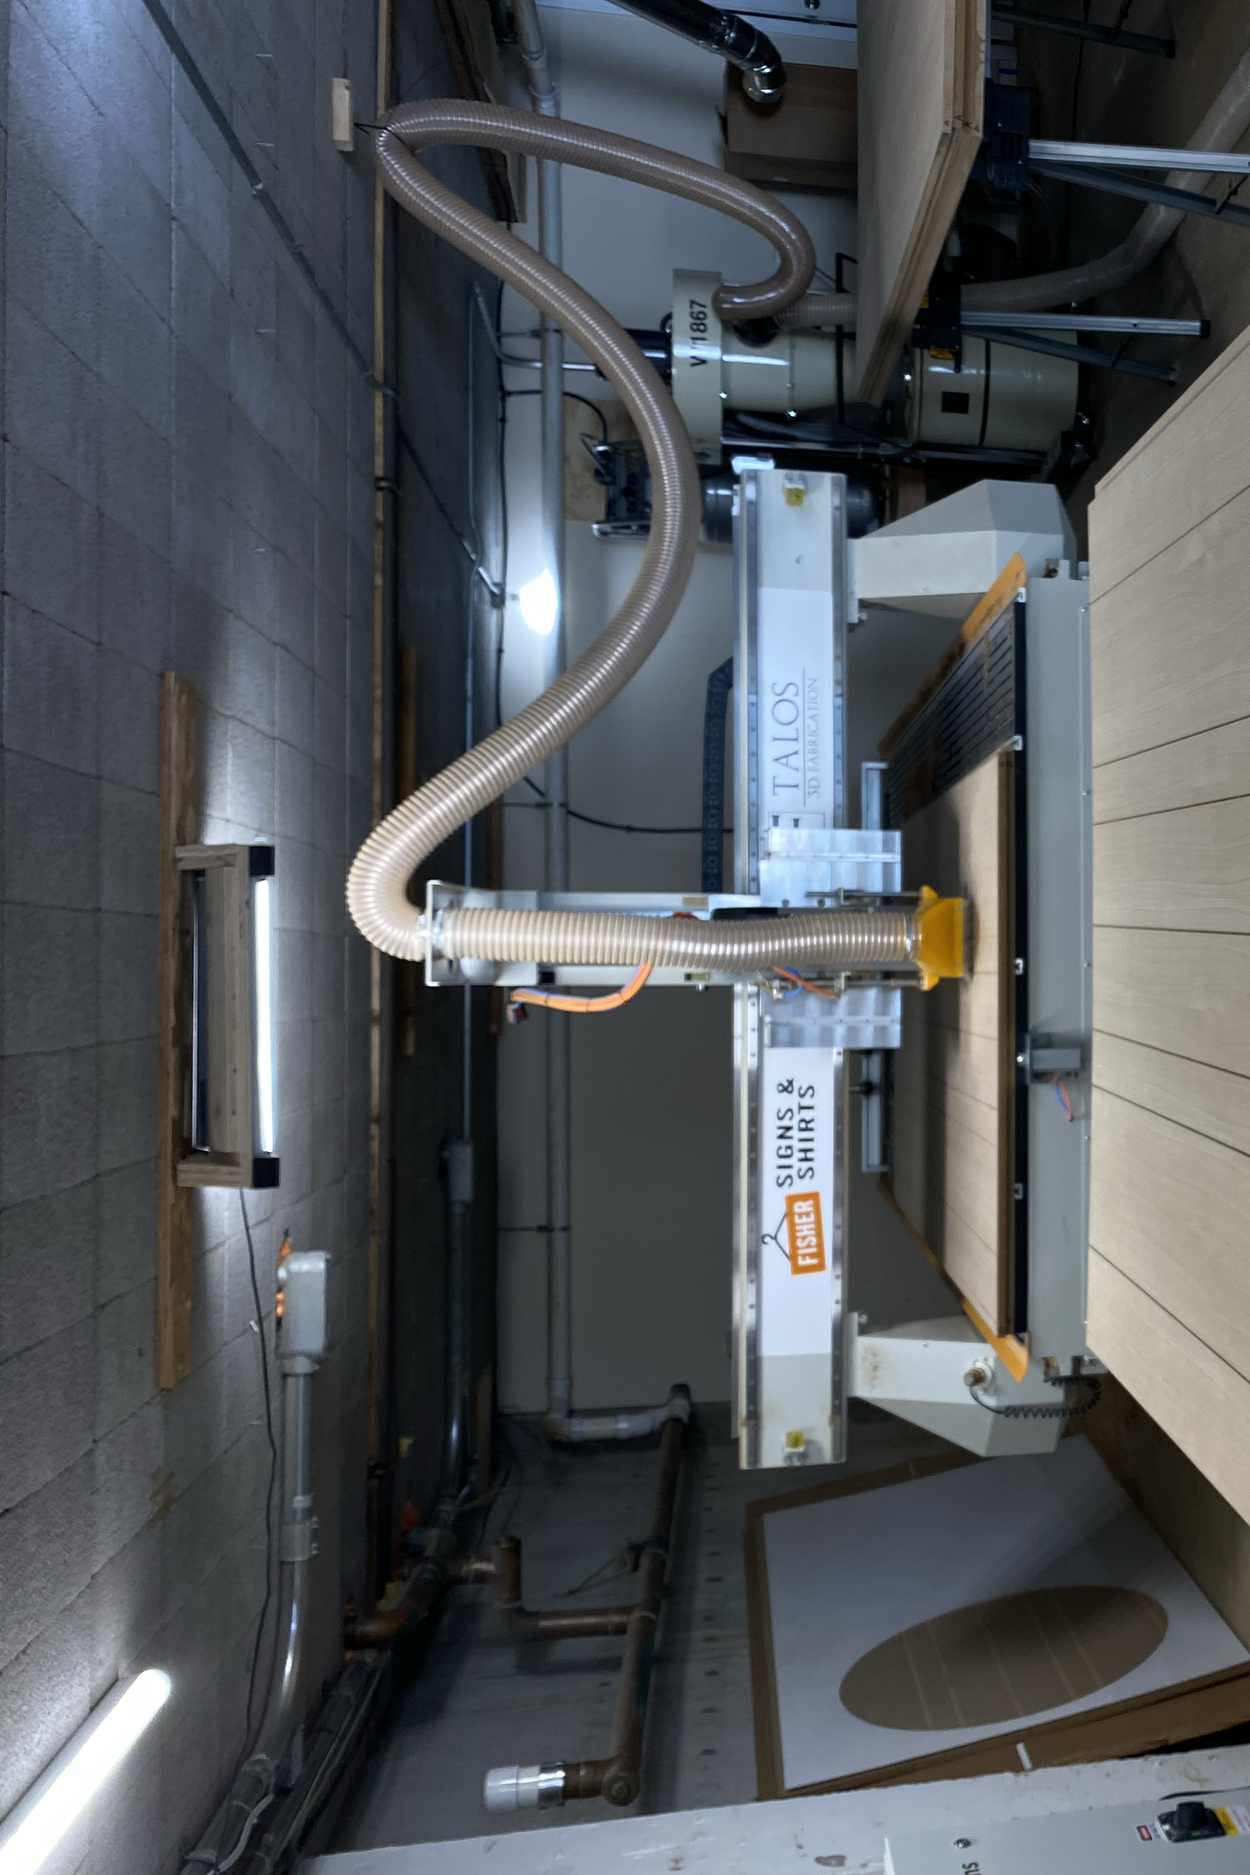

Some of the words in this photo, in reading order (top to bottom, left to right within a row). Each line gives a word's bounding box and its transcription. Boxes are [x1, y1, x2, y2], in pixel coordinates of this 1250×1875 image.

[772, 682, 799, 796] TALOS
[807, 678, 820, 773] FABRICATION
[807, 777, 820, 799] 3D
[777, 1078, 794, 1094] &
[776, 1107, 794, 1188] SIGNS
[797, 1085, 815, 1180] SHIRTS
[793, 1199, 819, 1267] FISHER
